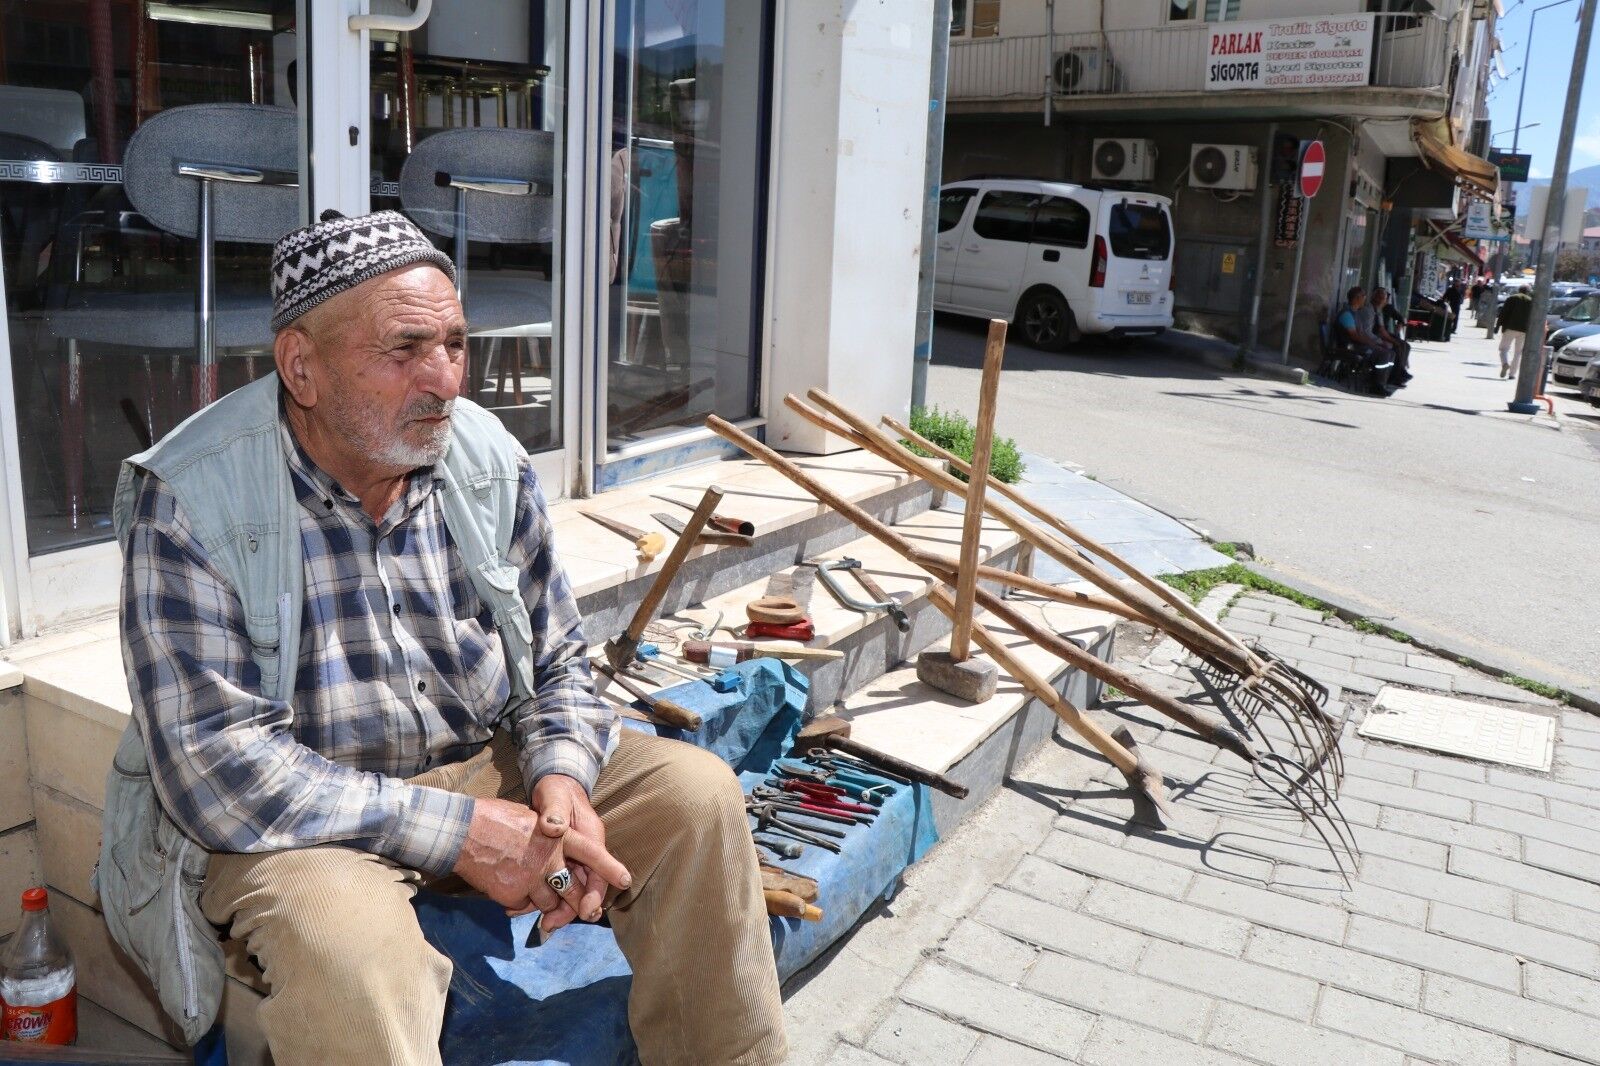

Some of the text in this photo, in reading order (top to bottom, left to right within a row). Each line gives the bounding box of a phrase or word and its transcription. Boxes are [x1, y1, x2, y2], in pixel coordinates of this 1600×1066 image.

[1269, 20, 1367, 37] Trafik Sigorta
[1211, 32, 1263, 55] PARLAK
[1211, 61, 1259, 82] SİGORTA
